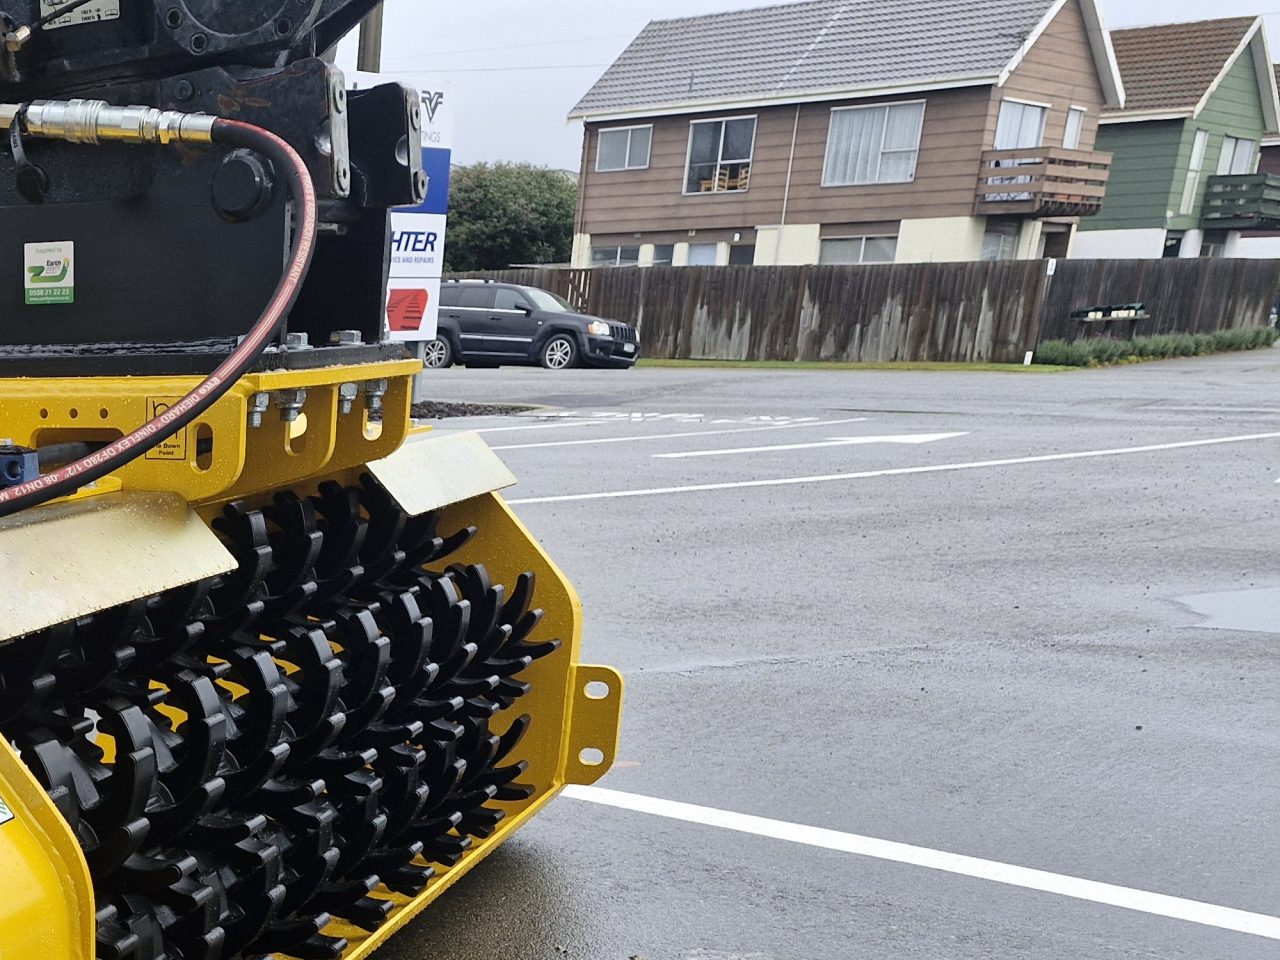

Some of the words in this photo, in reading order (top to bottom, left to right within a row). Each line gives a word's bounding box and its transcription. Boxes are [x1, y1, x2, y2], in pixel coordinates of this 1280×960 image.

[289, 240, 312, 282] RESISTANT
[414, 256, 434, 264] REPAIRS
[118, 424, 156, 451] DINFLEX
[15, 480, 43, 496] DN12
